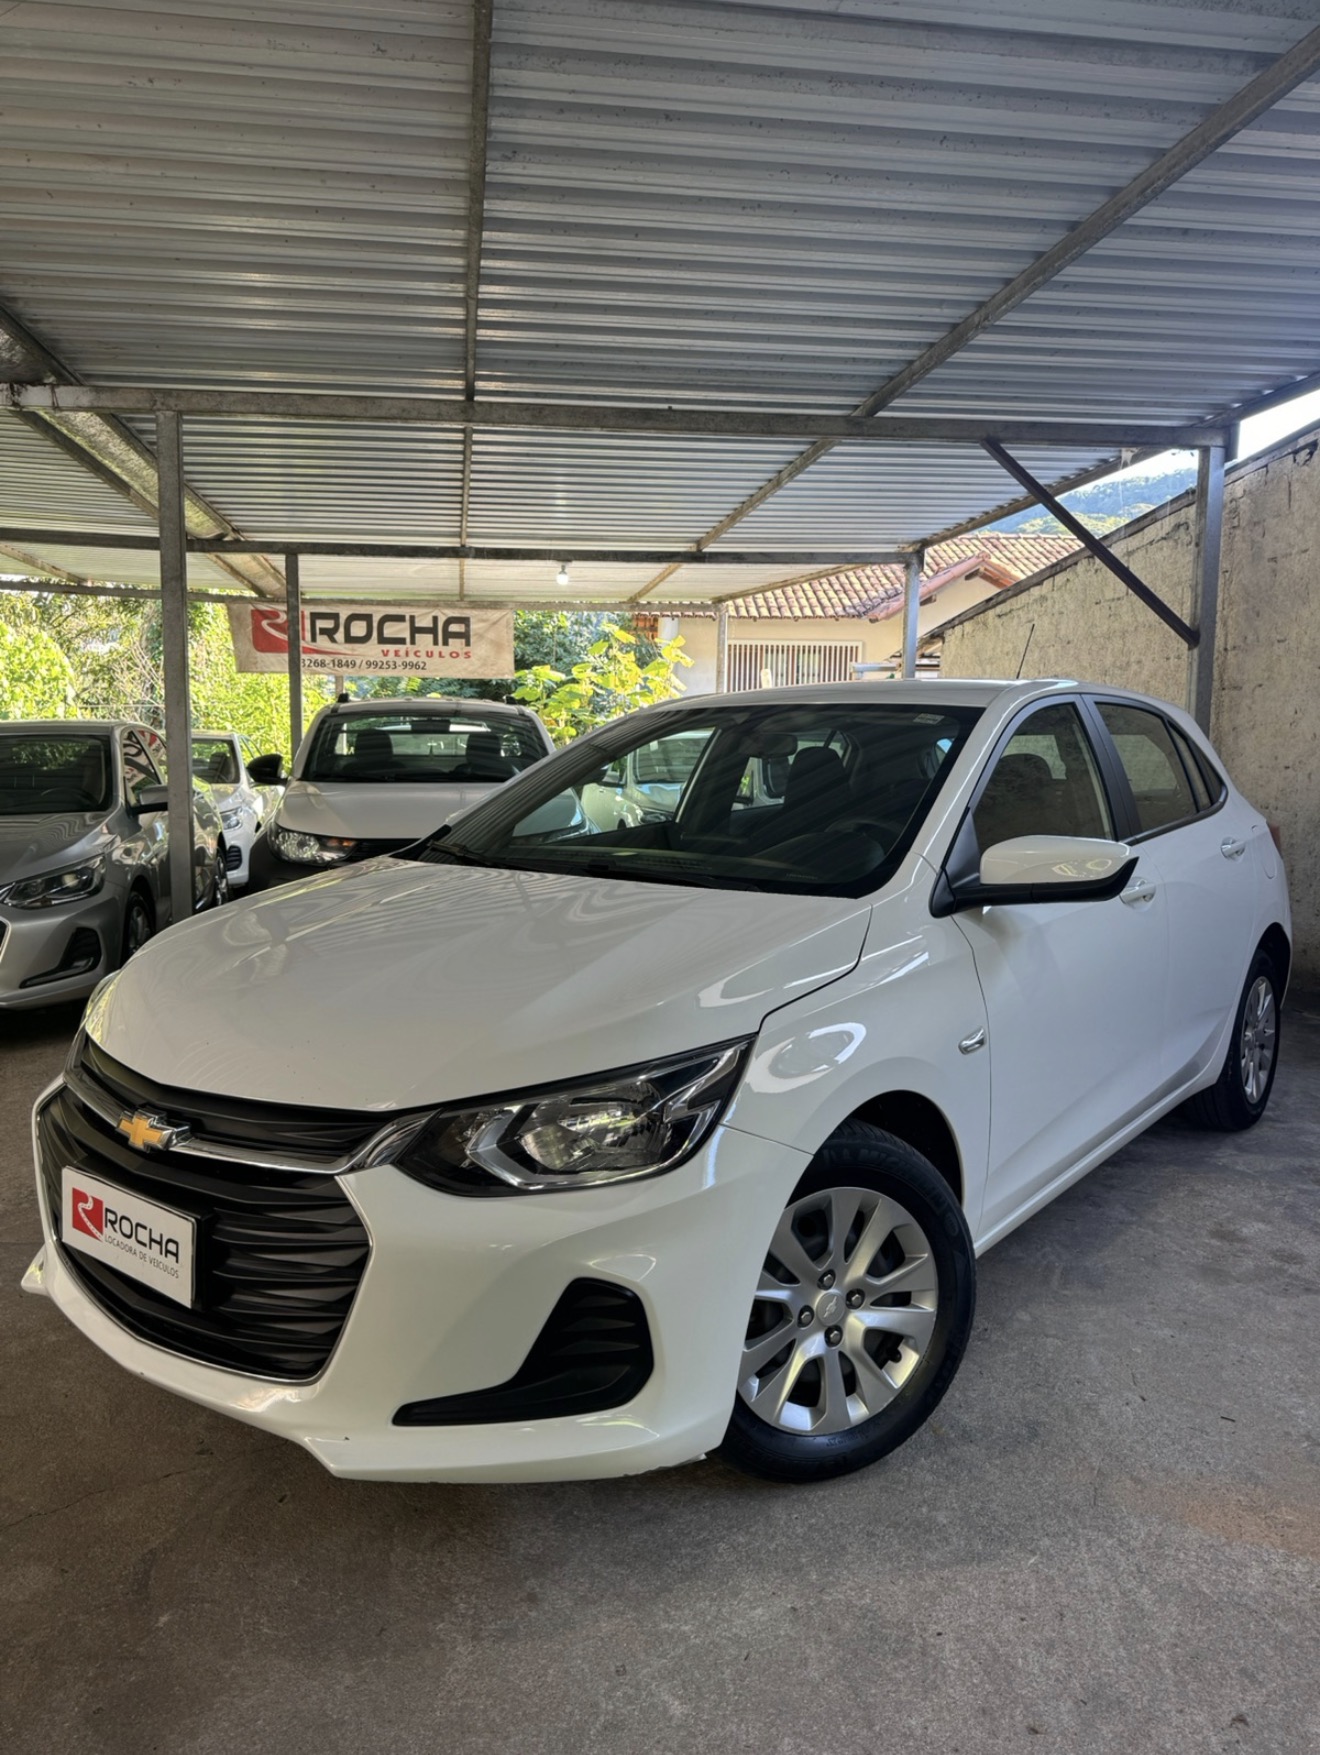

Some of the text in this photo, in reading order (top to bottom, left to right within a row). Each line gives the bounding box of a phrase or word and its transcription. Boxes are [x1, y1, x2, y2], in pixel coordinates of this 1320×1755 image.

[310, 612, 471, 647] ROCHA
[365, 660, 427, 671] 99253-9962
[381, 648, 472, 659] VEÍCULOS
[105, 1207, 179, 1264] ROCHA
[105, 1234, 138, 1257] LOCADORA
[139, 1251, 148, 1262] DE
